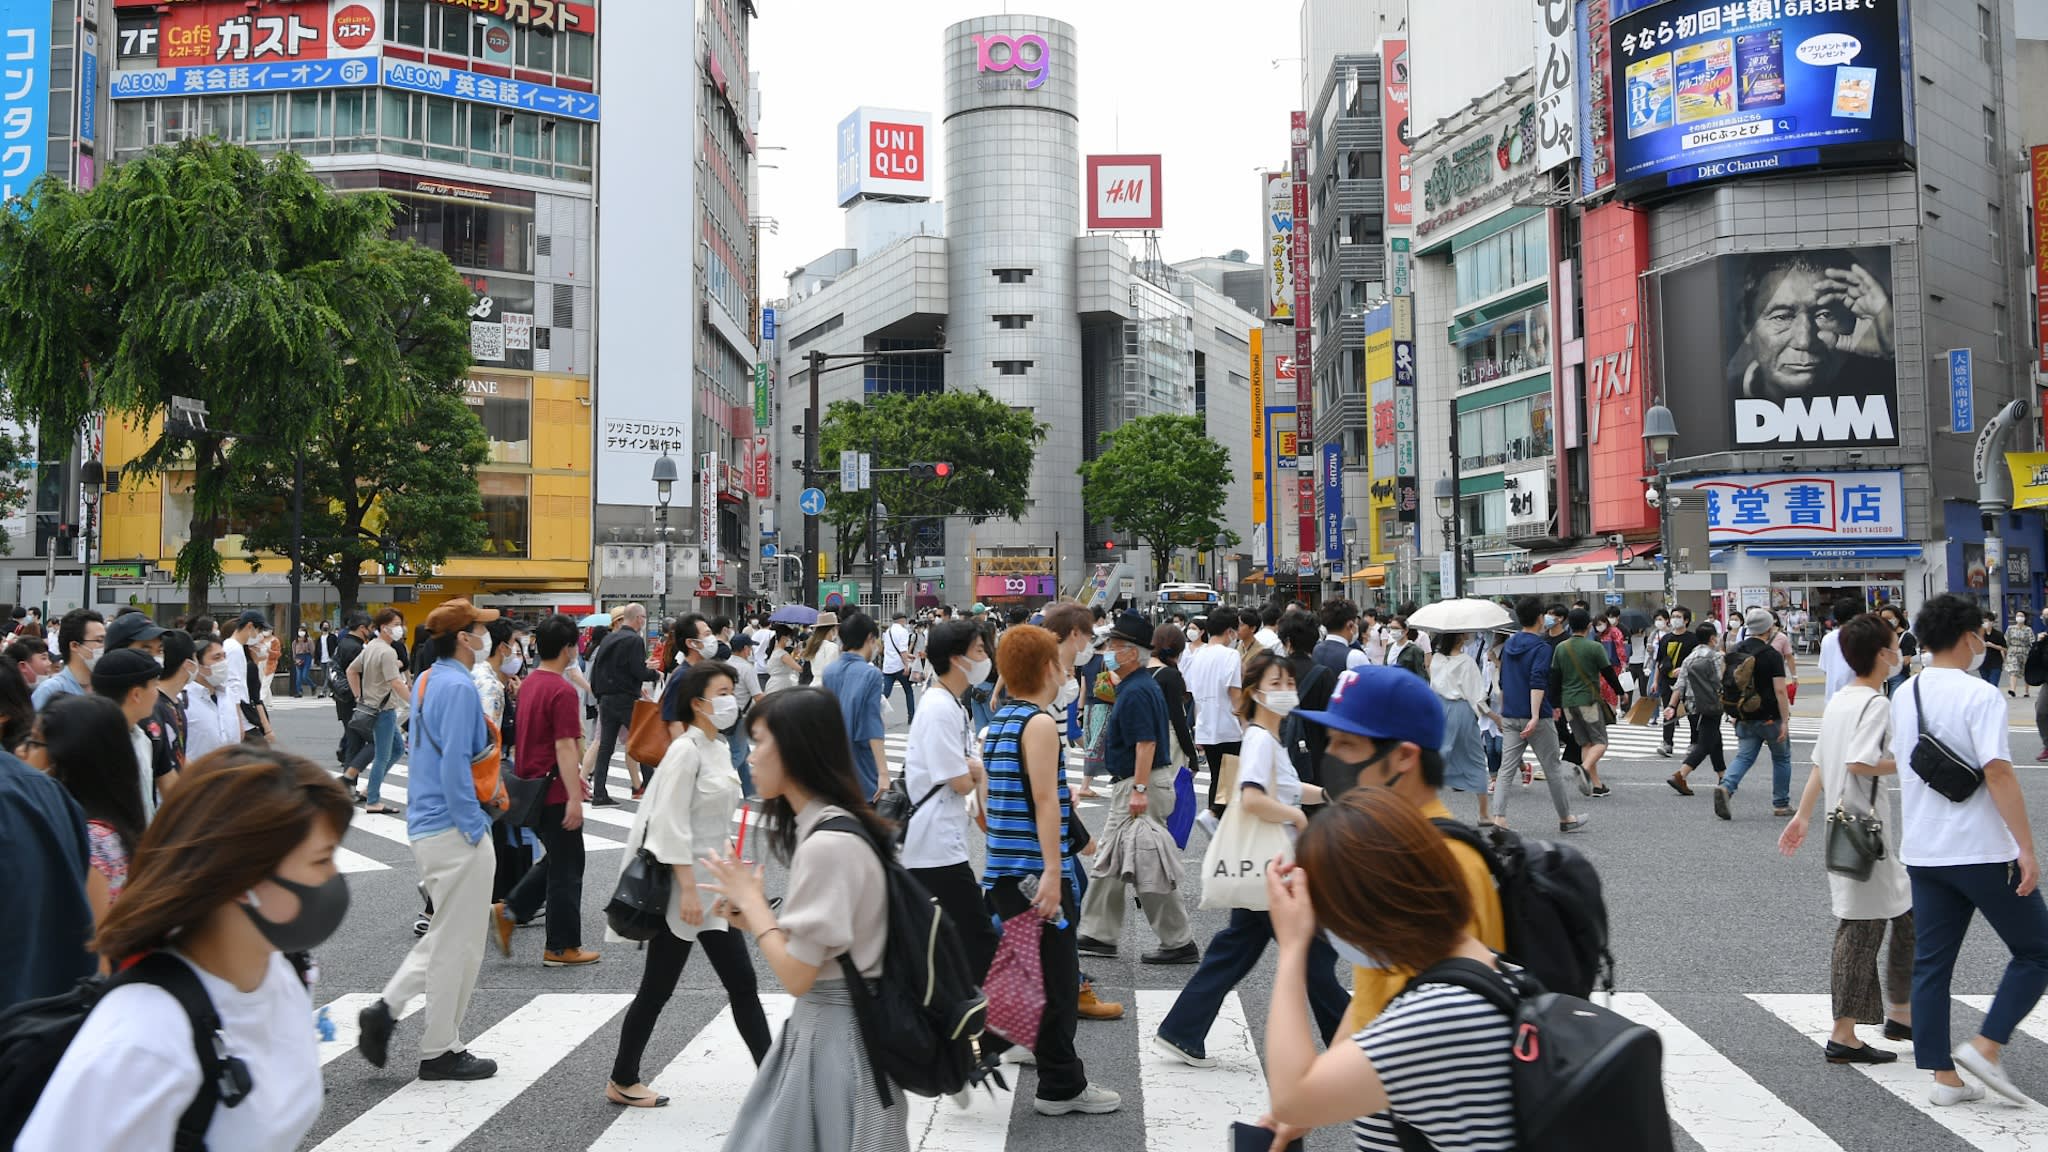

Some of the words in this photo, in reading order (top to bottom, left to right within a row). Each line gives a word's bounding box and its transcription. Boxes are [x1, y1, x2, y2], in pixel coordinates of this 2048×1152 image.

[120, 29, 158, 55] 7F
[168, 25, 212, 46] Café
[215, 15, 318, 61] ガスト
[338, 25, 372, 38] ガスト
[168, 45, 211, 58] レストラン
[971, 33, 1050, 90] 109
[119, 74, 168, 92] AEON
[184, 64, 333, 92] 英会話イーオン
[342, 64, 366, 82] 6F
[392, 65, 442, 89] AEON
[455, 73, 596, 115] 英会話イーオン
[1631, 85, 1648, 126] DHA
[875, 128, 914, 152] UNI
[1692, 123, 1760, 146] DHCぶっとび
[875, 152, 918, 176] QLO
[1697, 164, 1725, 178] DHC
[1727, 155, 1779, 174] Channel
[1105, 178, 1144, 205] H&M
[506, 326, 529, 337] テイク
[506, 337, 529, 348] アウト
[607, 422, 681, 438] ツツミプロジェクト
[1735, 395, 1895, 444] DMM
[607, 436, 682, 453] デザイン製作中
[756, 460, 766, 485] アコム
[1329, 452, 1338, 487] MIZUHO
[1864, 526, 1893, 534] TAISEIDO
[1004, 578, 1027, 594] 109
[1331, 669, 1361, 704] T
